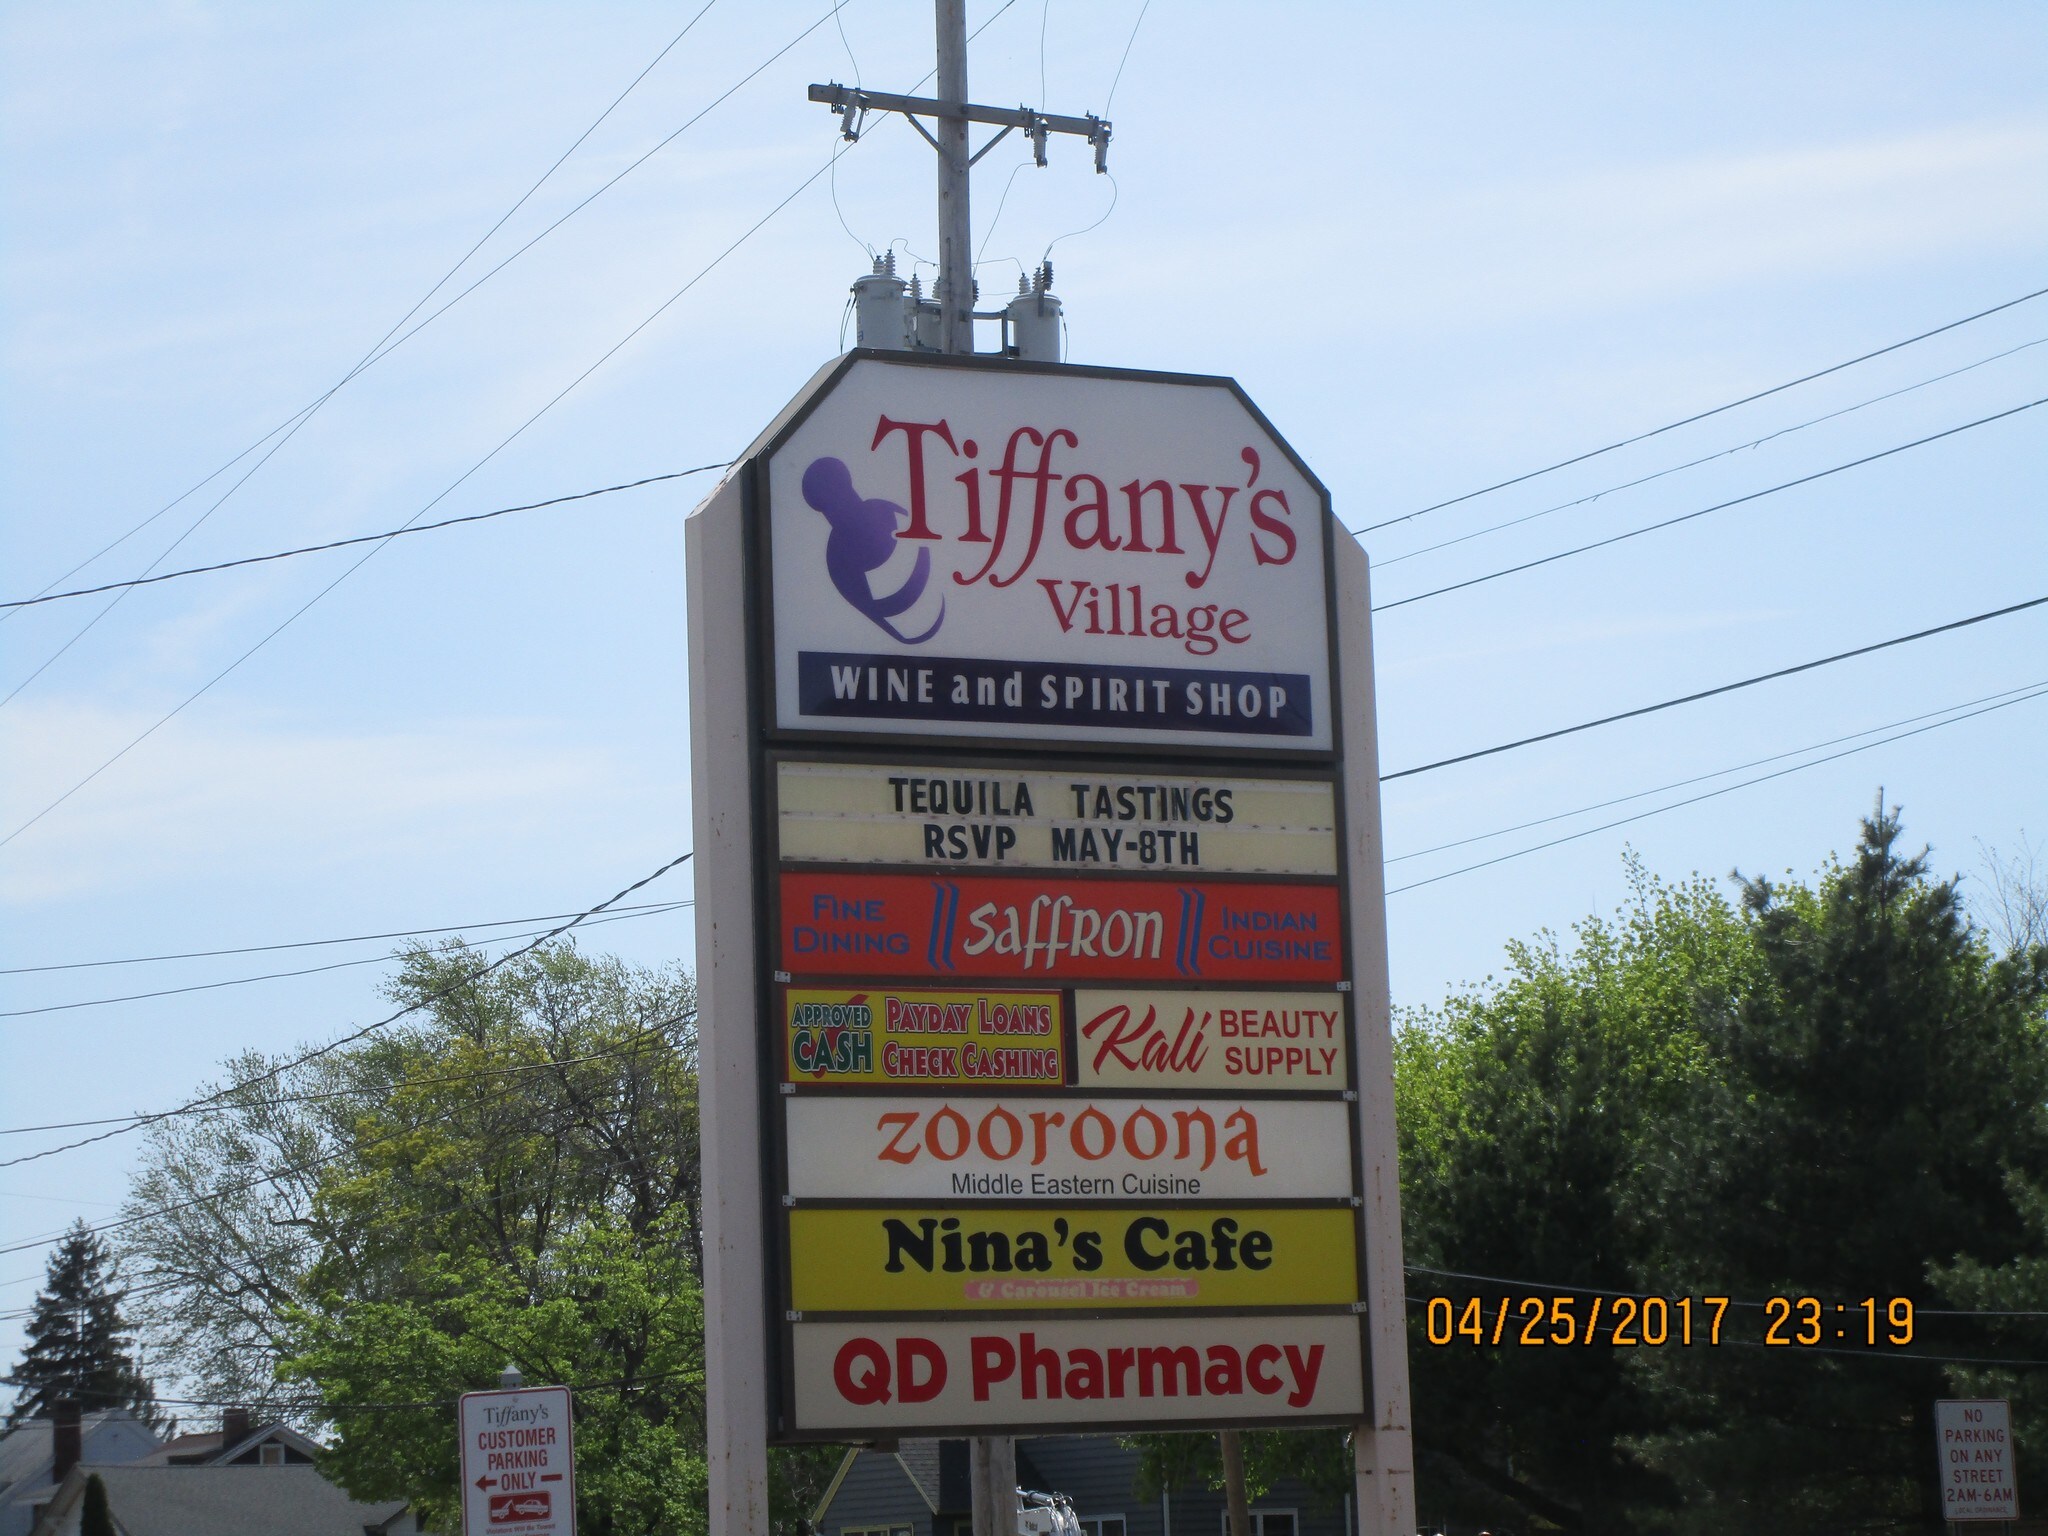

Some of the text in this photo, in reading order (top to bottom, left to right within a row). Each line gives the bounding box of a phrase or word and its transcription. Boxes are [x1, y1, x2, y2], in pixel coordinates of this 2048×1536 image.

[870, 413, 1298, 589] Tiffany's
[1036, 578, 1252, 656] Village
[830, 664, 1288, 719] WINE and SPIRIT SHOP
[888, 776, 1235, 824] TEQUILA TASTINGS
[923, 823, 1199, 866] RSVP MAY-8TH
[793, 925, 911, 955] DINING
[791, 1003, 872, 1029] APPROVED
[1220, 1009, 1339, 1038] BEAUTY
[792, 1031, 873, 1073] CASH
[1081, 1005, 1213, 1075] Kali
[1225, 1046, 1339, 1076] SUPPLY
[876, 1103, 1268, 1177] zooroona
[952, 1173, 1201, 1195] Middle Eastern Cuisine
[881, 1217, 1273, 1273] Nina's Cafe
[1125, 1281, 1187, 1297] Cream
[833, 1332, 1325, 1408] QD Pharmacy
[483, 1404, 549, 1427] Tiffany's
[1964, 1409, 1983, 1423] NO
[478, 1427, 556, 1450] CUSTOMER
[1945, 1429, 2005, 1443] PARKING
[488, 1450, 548, 1471] PARKING
[1950, 1449, 2002, 1463] ON ANY
[501, 1472, 537, 1491] ONLY
[1953, 1469, 2003, 1483] STREET
